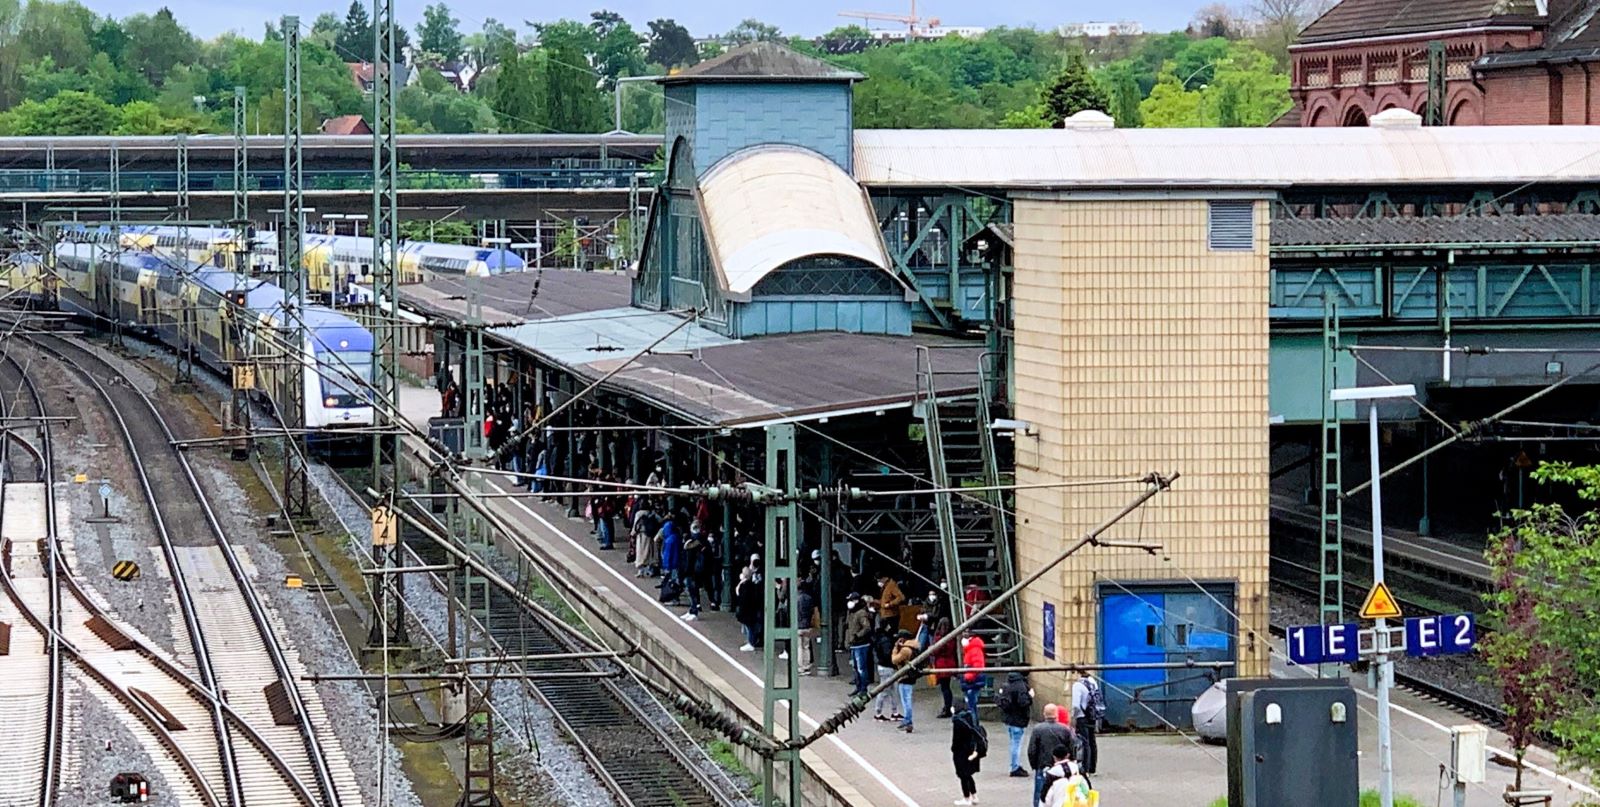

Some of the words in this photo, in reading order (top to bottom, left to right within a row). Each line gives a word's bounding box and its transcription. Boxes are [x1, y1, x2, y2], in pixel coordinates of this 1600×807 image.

[1293, 627, 1305, 657] 1
[1328, 625, 1346, 655] E
[1419, 618, 1436, 648] E
[1454, 615, 1471, 645] 2
